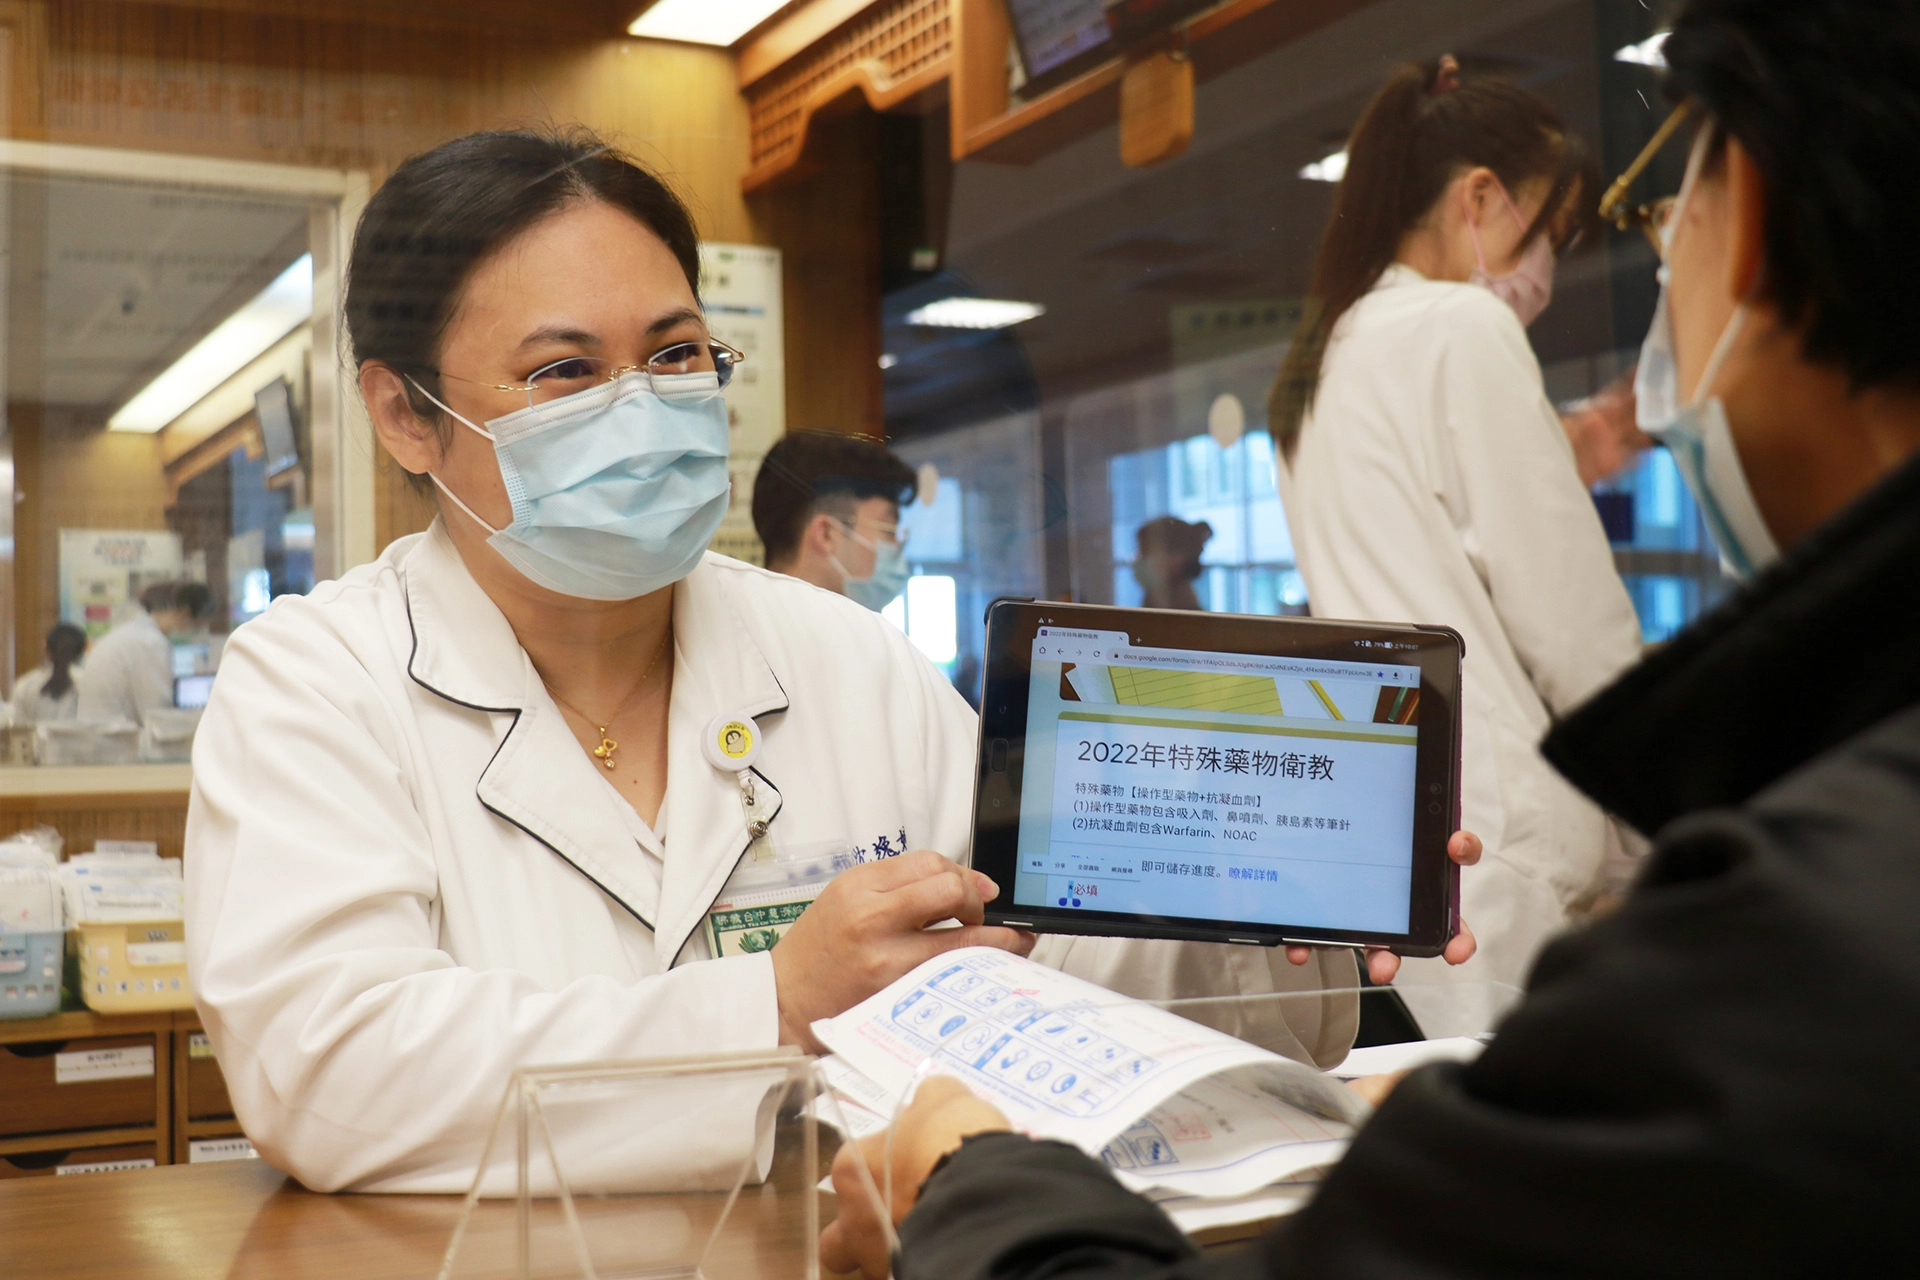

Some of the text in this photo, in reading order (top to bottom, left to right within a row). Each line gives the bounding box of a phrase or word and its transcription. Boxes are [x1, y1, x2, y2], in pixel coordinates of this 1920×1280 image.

[1077, 740, 1335, 782] 2022年特殊藥物衛教
[1228, 866, 1279, 882] 瞭解詳情
